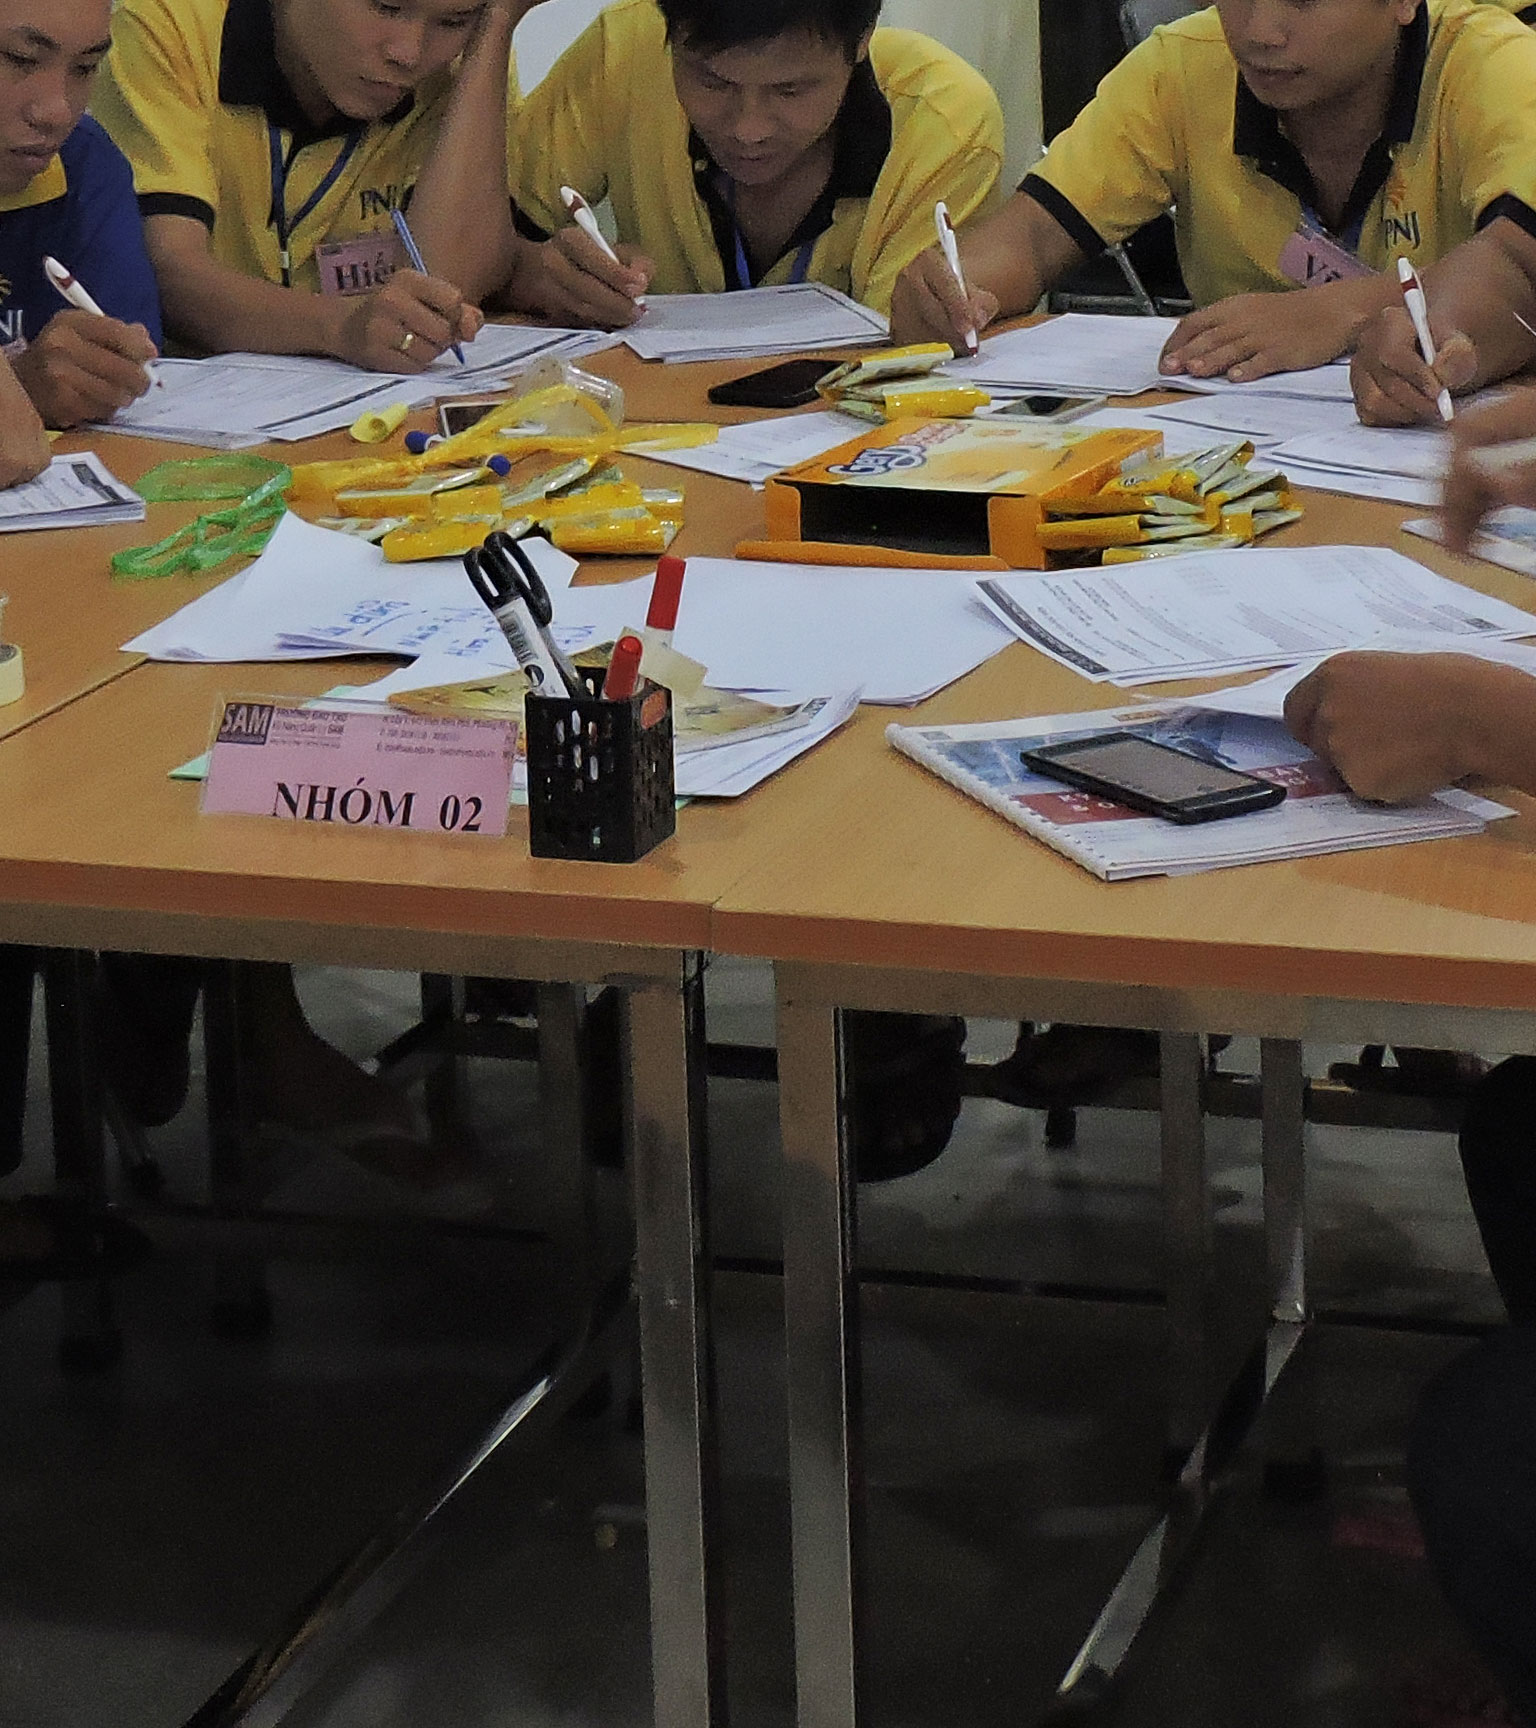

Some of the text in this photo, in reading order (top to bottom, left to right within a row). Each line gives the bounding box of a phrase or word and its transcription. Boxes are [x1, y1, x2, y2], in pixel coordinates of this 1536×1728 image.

[220, 704, 270, 735] SAM
[272, 777, 482, 832] NHÓM 02
